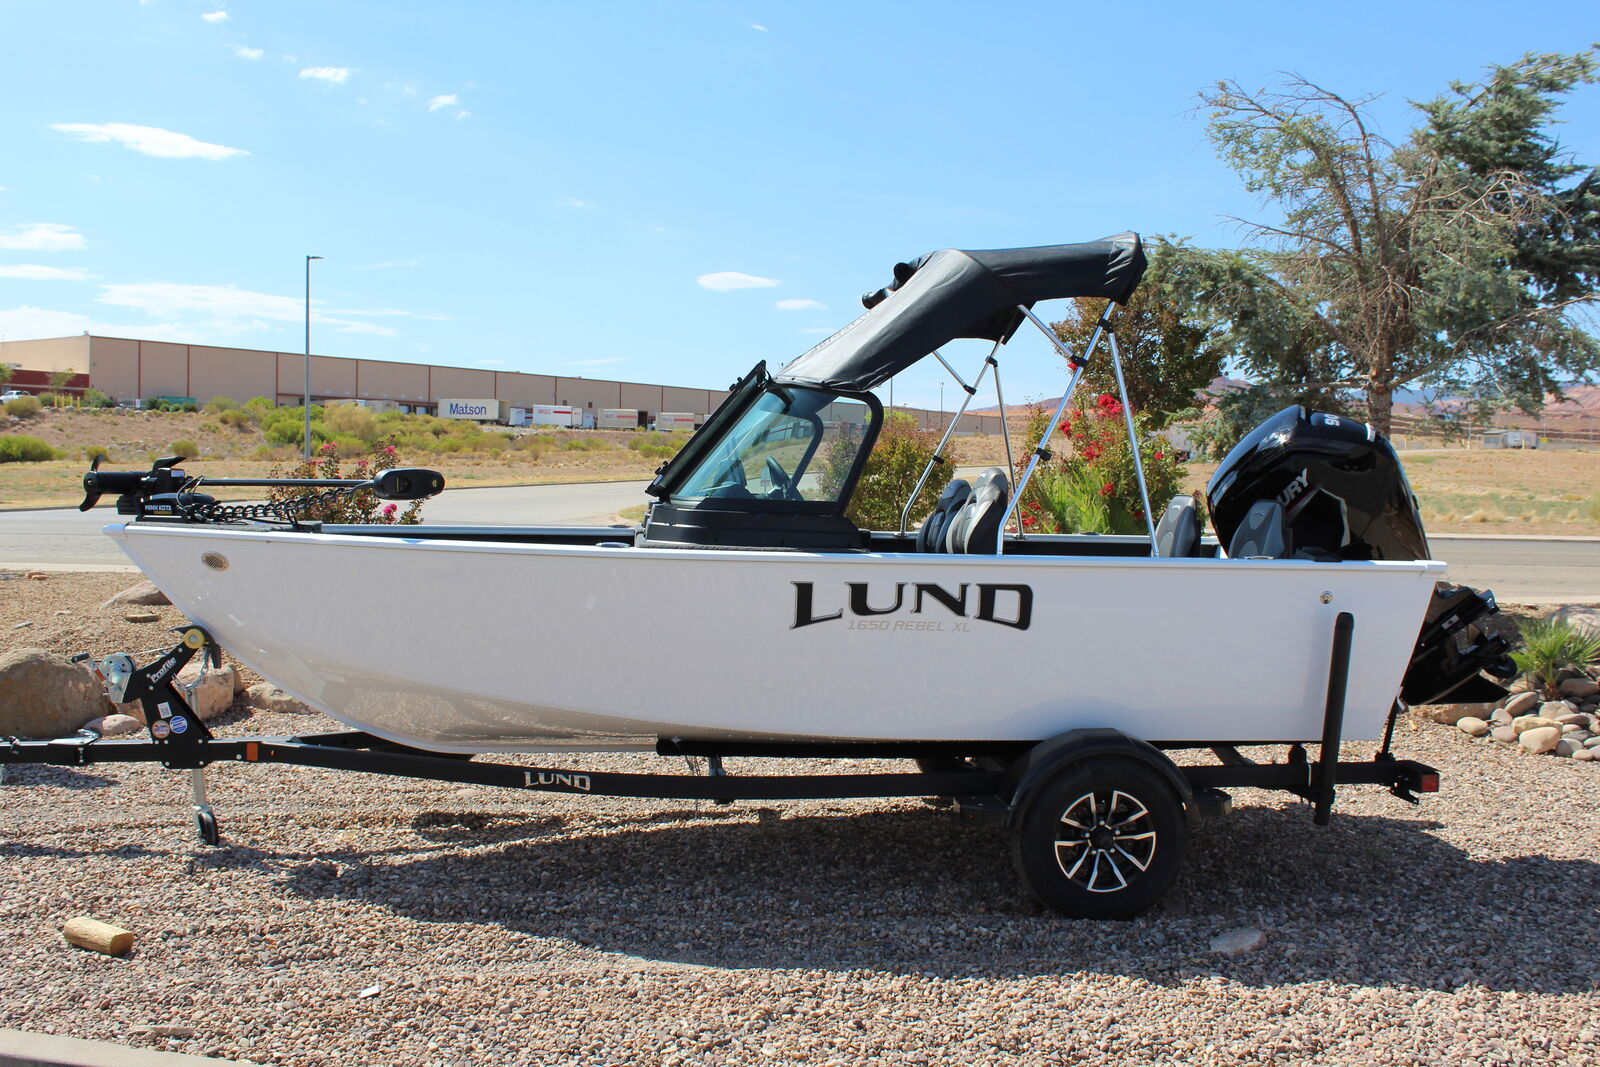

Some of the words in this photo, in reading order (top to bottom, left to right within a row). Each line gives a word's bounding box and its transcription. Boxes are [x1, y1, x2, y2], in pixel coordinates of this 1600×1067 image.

[449, 402, 487, 416] Matson
[788, 580, 1034, 631] LUND
[846, 620, 890, 632] 1650
[892, 620, 945, 632] REBEL
[951, 621, 972, 632] XL
[150, 656, 178, 684] Profile
[523, 771, 591, 792] LUND
